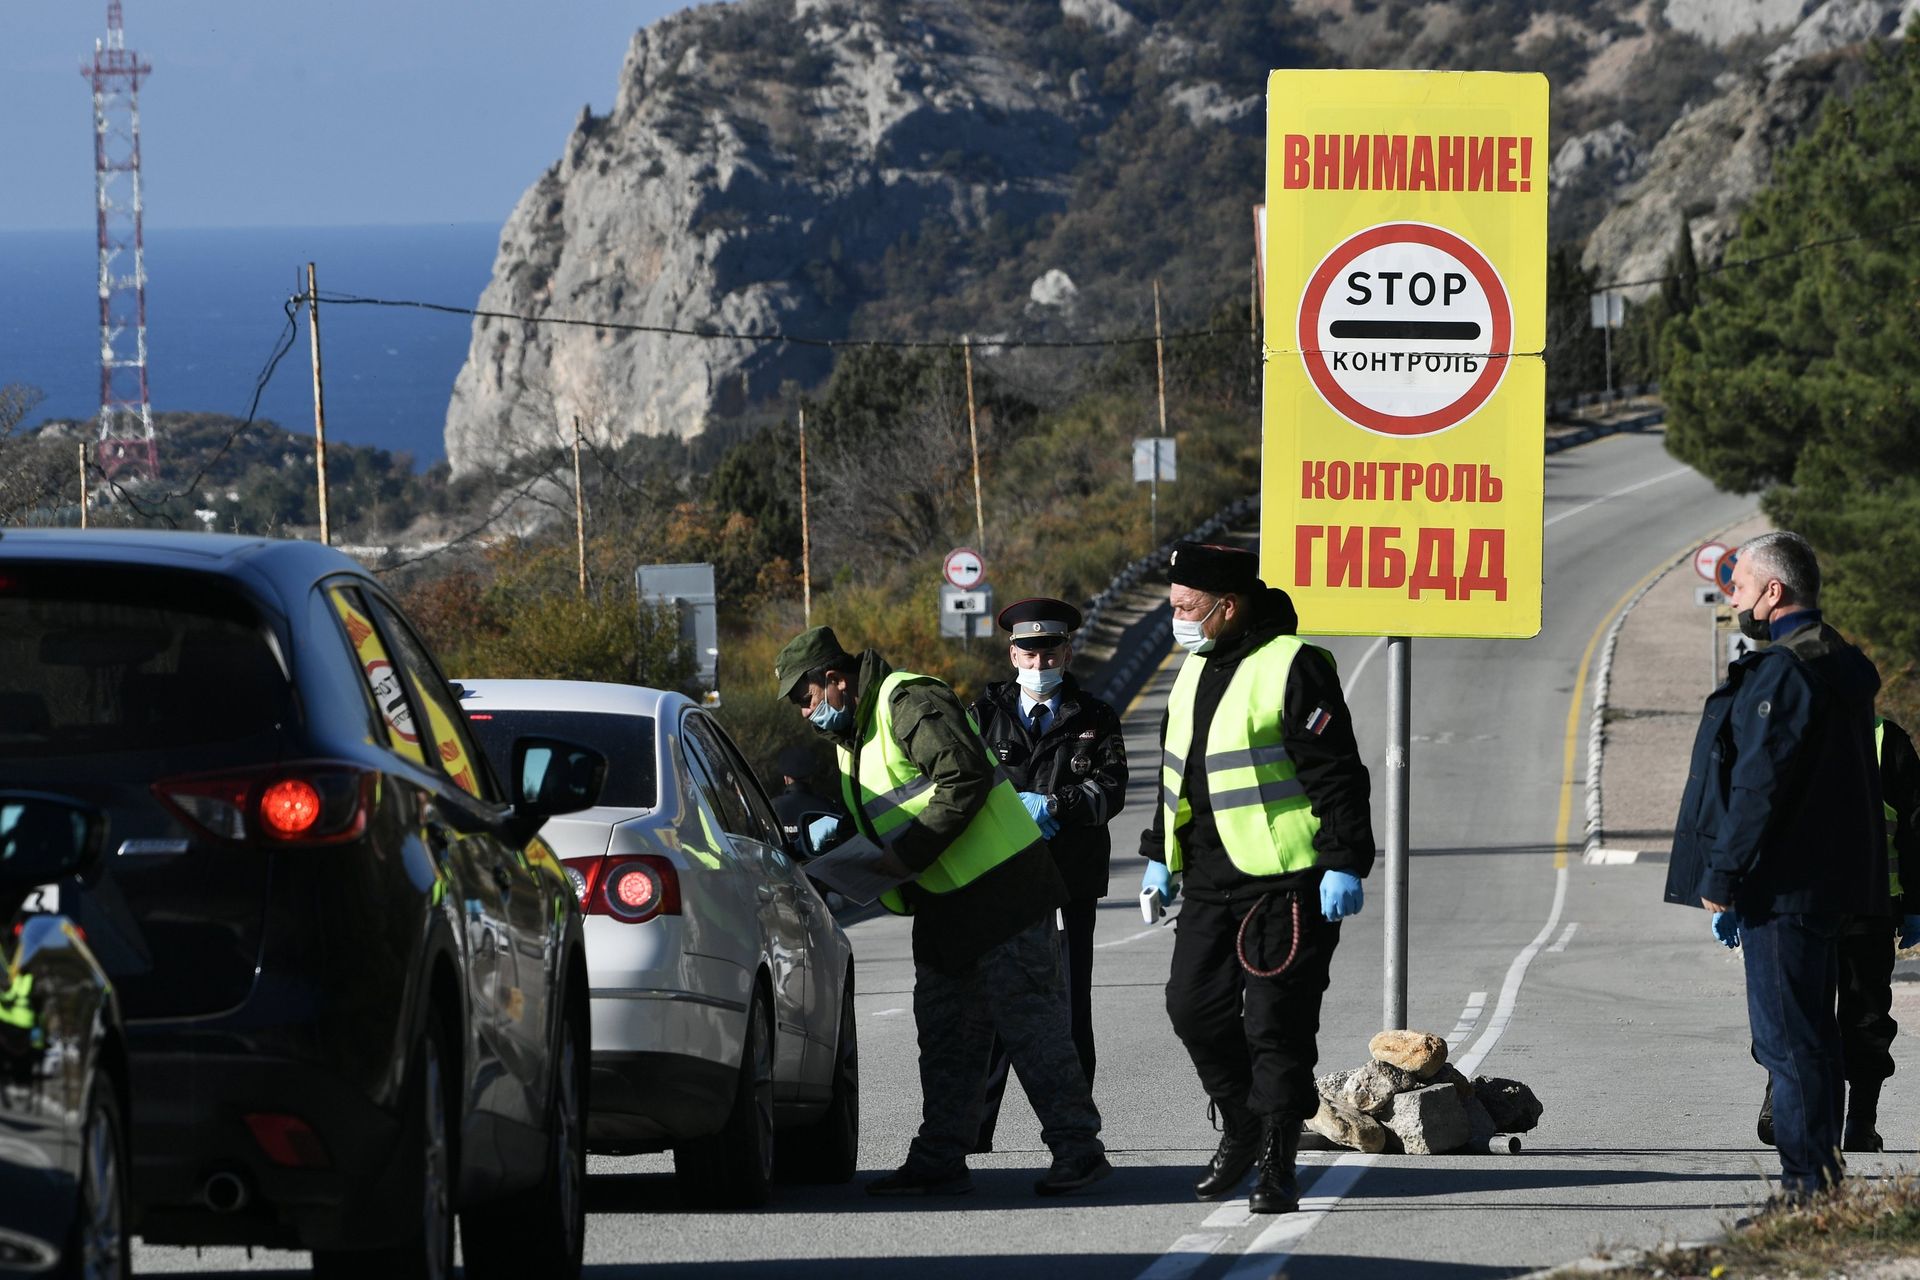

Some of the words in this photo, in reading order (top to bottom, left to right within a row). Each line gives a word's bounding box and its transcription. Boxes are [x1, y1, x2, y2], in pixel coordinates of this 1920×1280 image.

[1283, 134, 1533, 193] ВНИМАНИЕ!
[1346, 271, 1467, 306] STOP
[1333, 352, 1478, 373] КОНТРОЛЬ
[1302, 460, 1503, 503] КОНТРОЛЬ
[1294, 525, 1508, 602] ГИБДД
